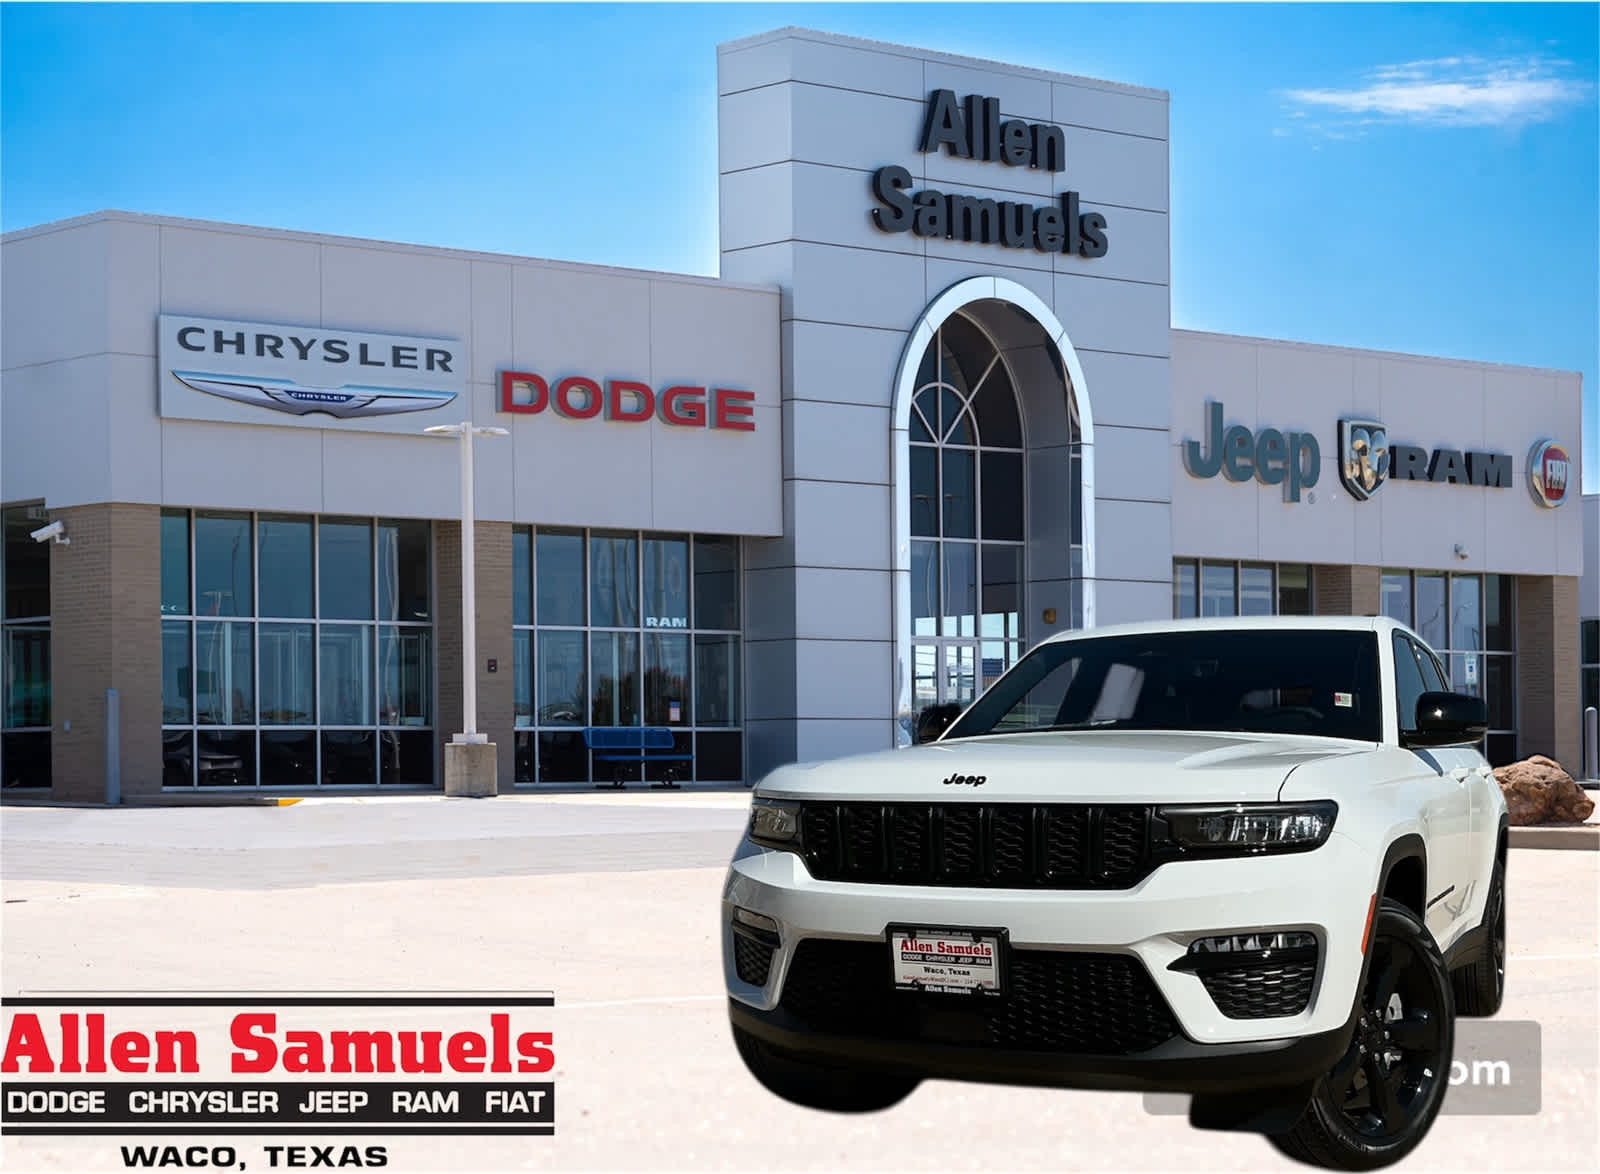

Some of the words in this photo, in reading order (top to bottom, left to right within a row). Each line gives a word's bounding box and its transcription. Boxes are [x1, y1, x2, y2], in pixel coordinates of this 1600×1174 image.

[918, 88, 1066, 173] Allen
[871, 165, 1109, 258] Samuels
[176, 326, 454, 373] CHRYSLER
[291, 393, 347, 401] CHRYSLER
[496, 370, 756, 432] DODGE
[1182, 399, 1321, 503] Jeep
[1389, 444, 1513, 488] RAM
[646, 616, 687, 628] RAM
[943, 773, 987, 787] Jeep
[901, 939, 932, 952] Allen
[937, 942, 992, 955] Samuels
[923, 966, 947, 975] Waco,
[948, 968, 971, 976] Texas
